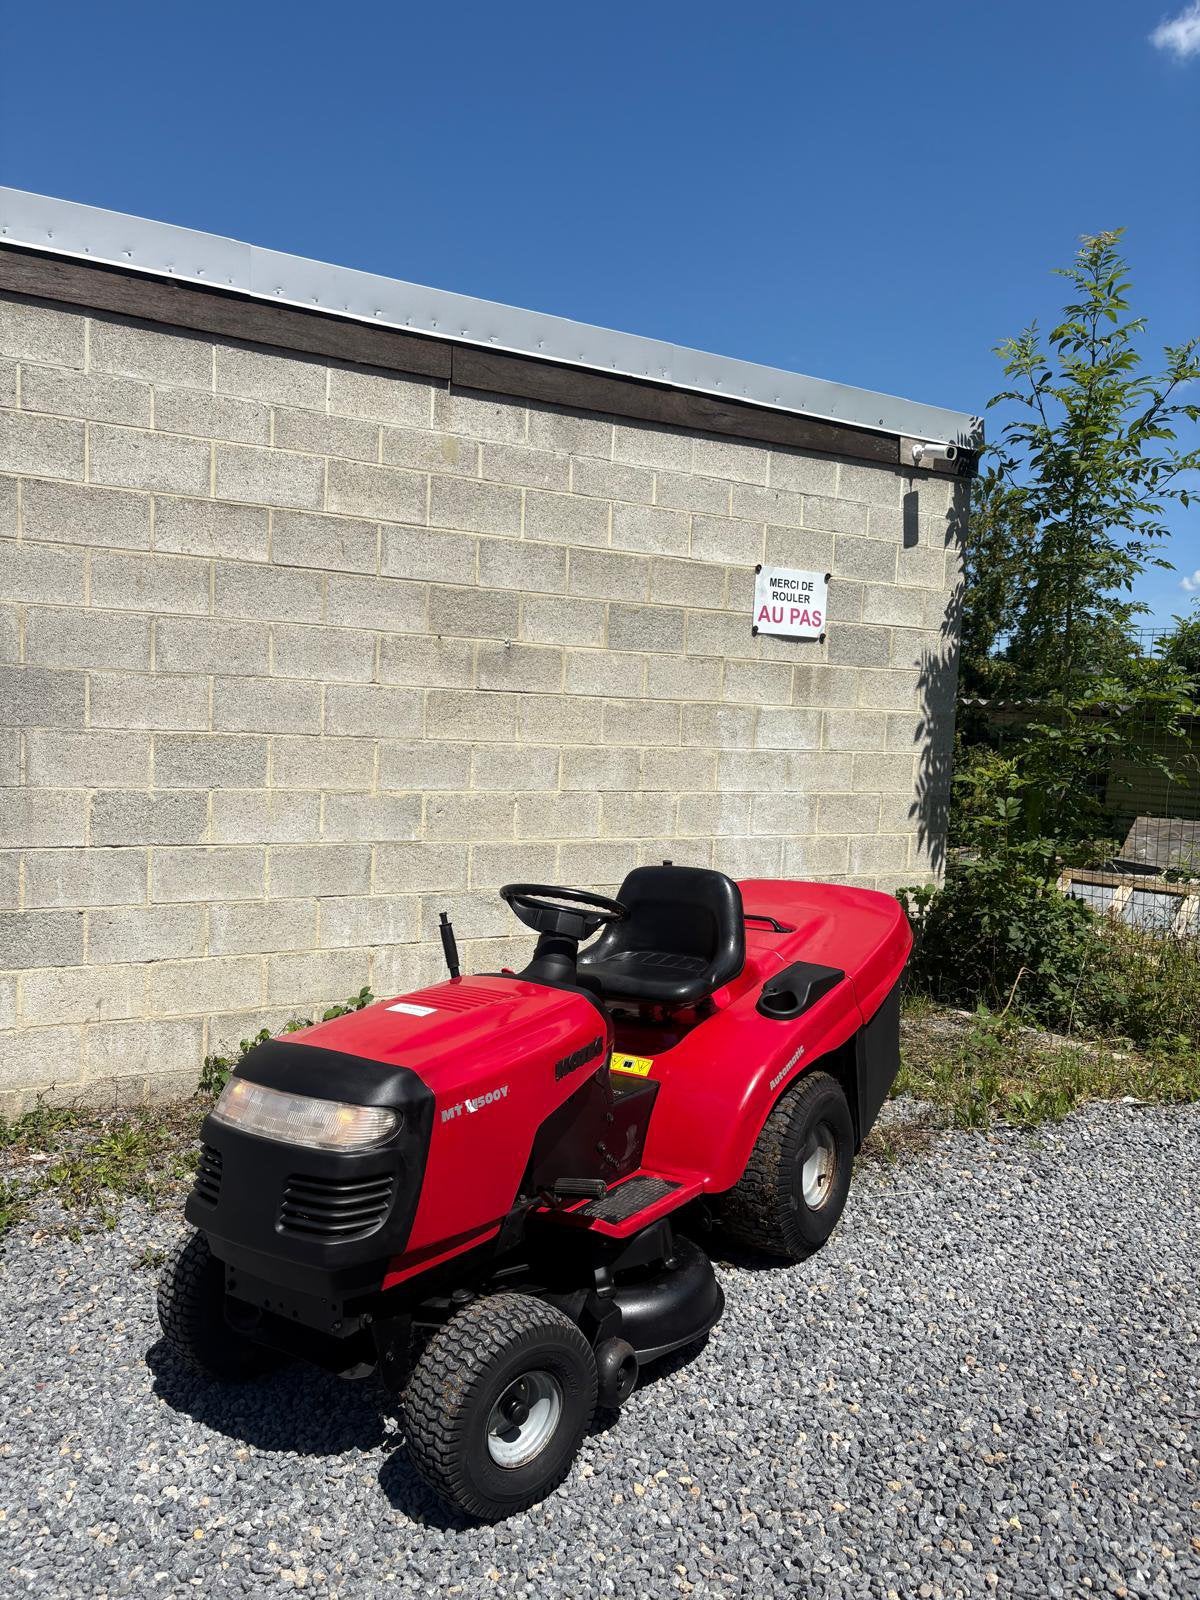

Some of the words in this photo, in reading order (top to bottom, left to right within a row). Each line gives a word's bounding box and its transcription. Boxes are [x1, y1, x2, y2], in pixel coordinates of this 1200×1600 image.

[769, 577, 799, 590] MERCI
[801, 581, 814, 592] DE
[772, 591, 810, 604] ROULER
[757, 605, 784, 623] AU
[789, 607, 822, 628] PAS
[769, 1045, 805, 1091] Automatic
